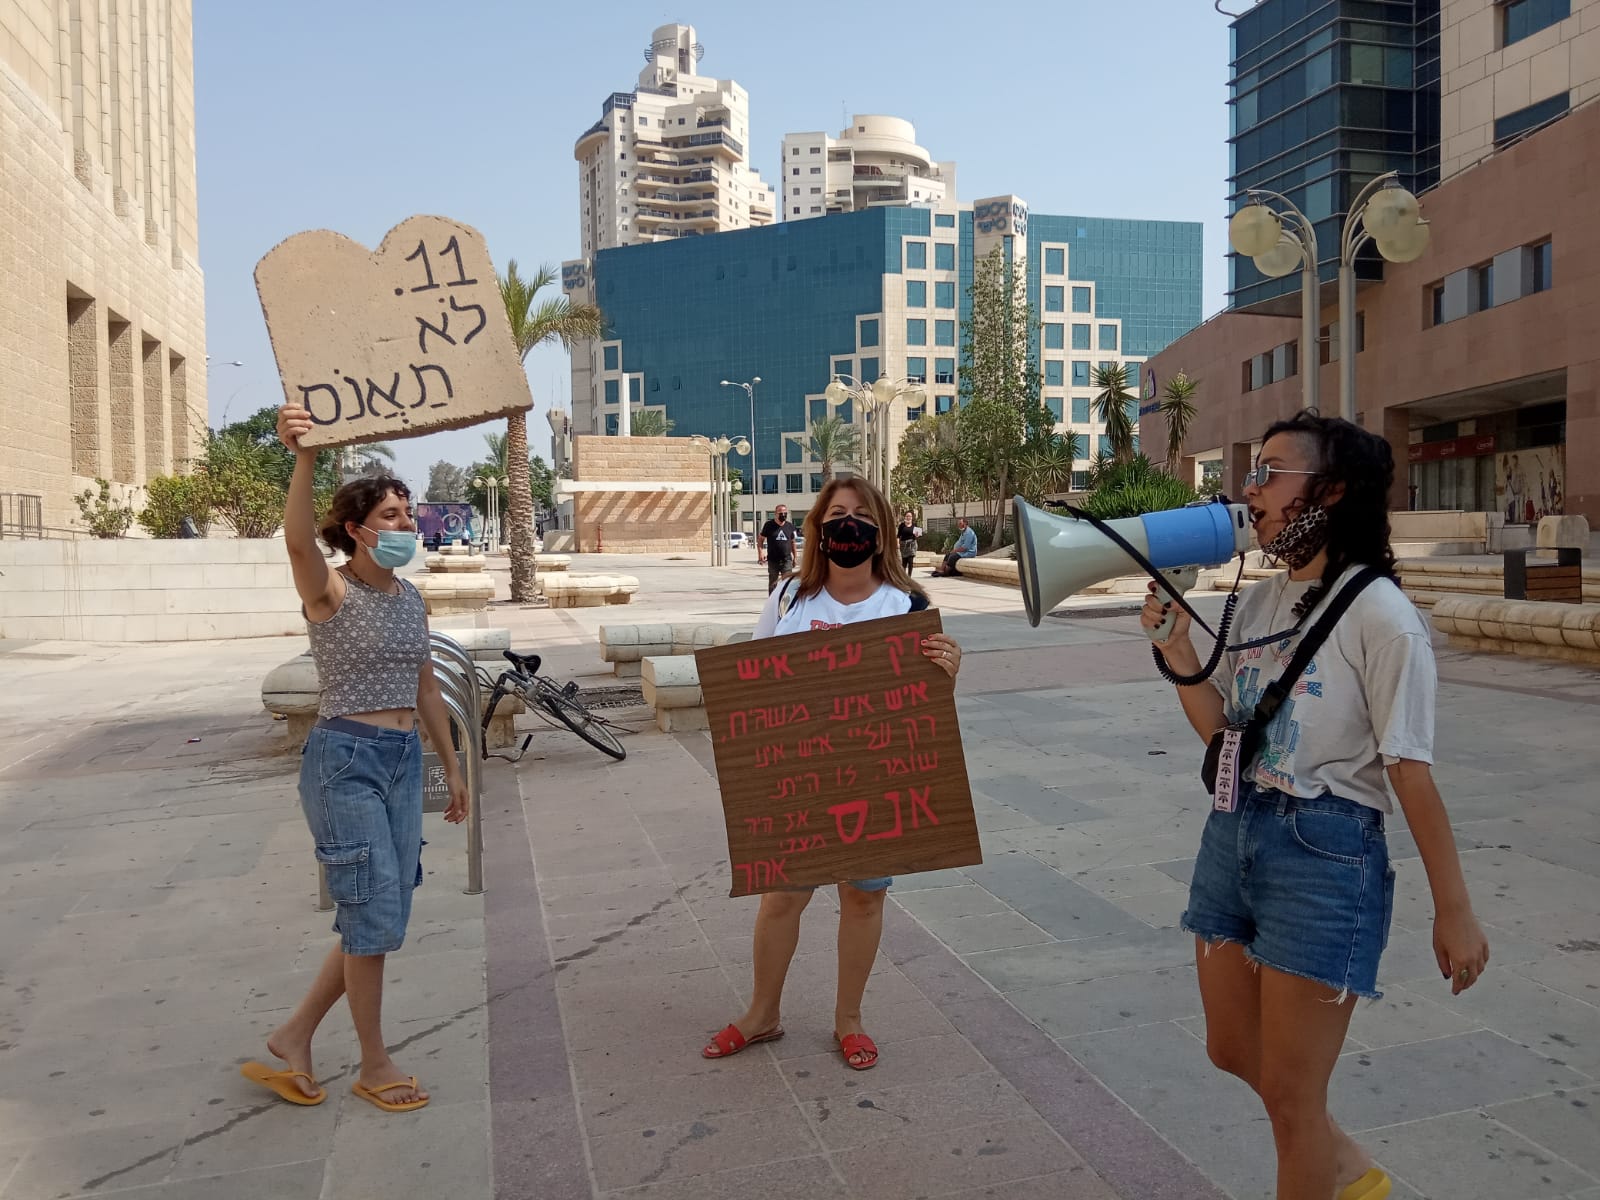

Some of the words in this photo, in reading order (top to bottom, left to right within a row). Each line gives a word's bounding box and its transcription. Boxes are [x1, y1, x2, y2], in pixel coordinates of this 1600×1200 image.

[736, 653, 795, 681] איש
[884, 630, 922, 677] רק
[884, 680, 930, 712] איש
[798, 734, 835, 758] איש
[901, 714, 937, 750] רק
[835, 764, 858, 787] לו
[783, 808, 810, 834] אז
[826, 784, 941, 845] אנס
[734, 857, 791, 893] אחר
